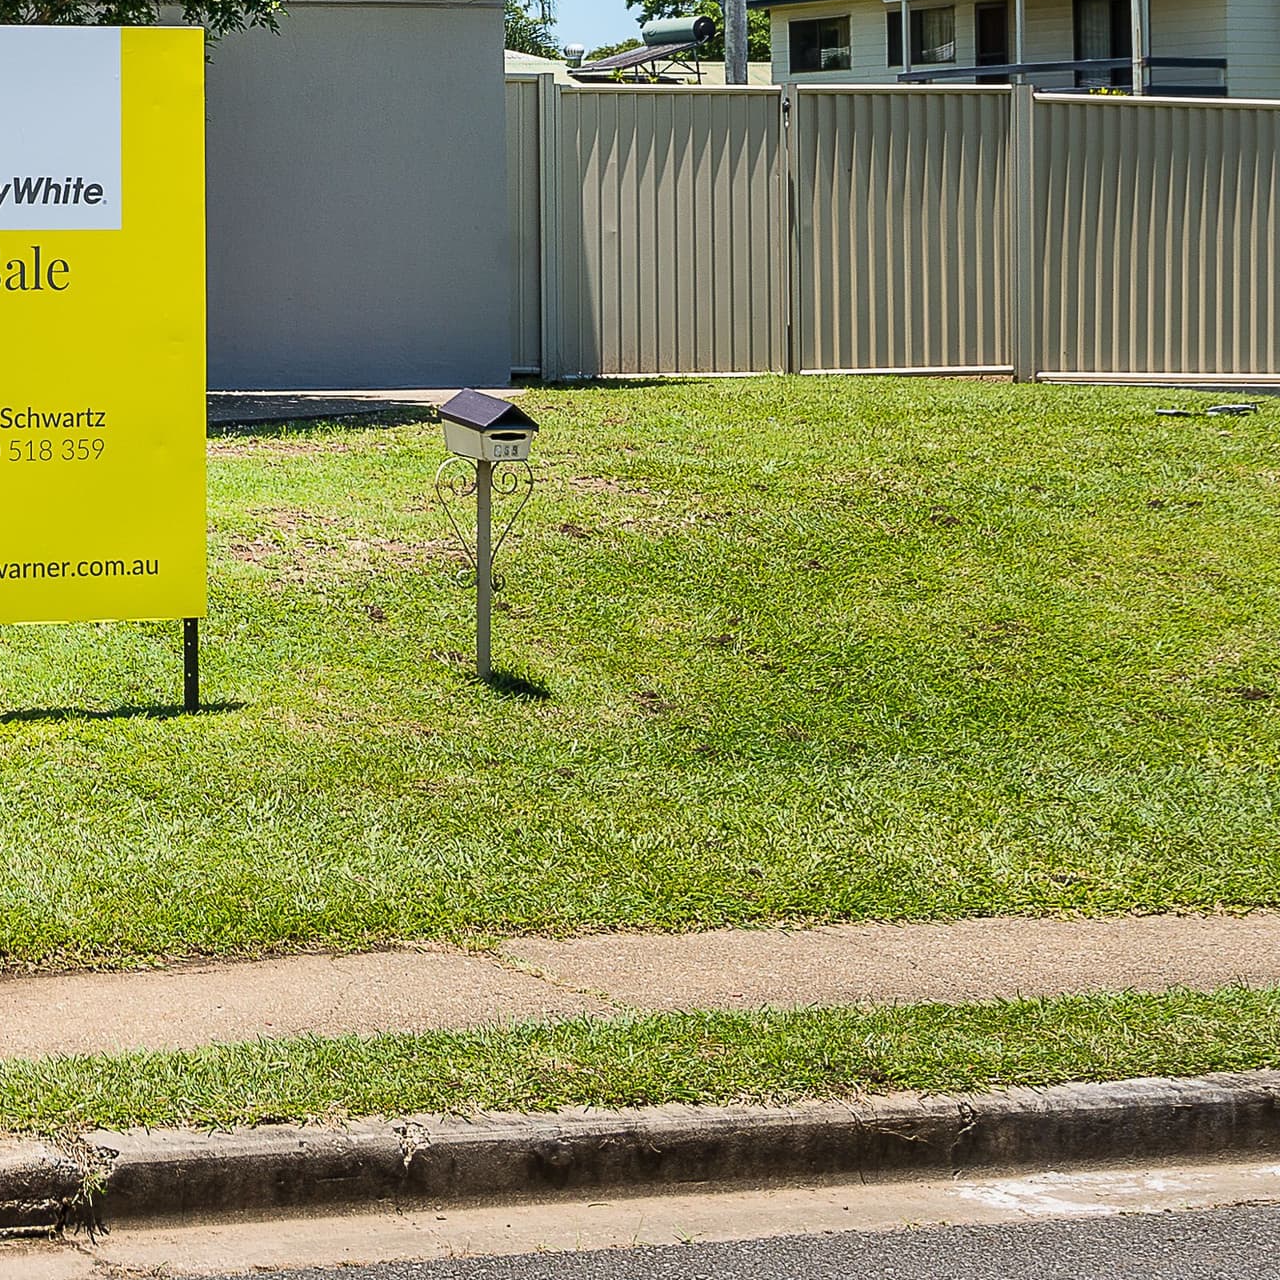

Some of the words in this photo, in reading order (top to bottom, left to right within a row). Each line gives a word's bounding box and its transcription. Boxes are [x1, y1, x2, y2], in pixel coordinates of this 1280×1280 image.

[0, 406, 107, 429] Schwartz
[8, 439, 53, 462] 518
[61, 438, 105, 462] 359
